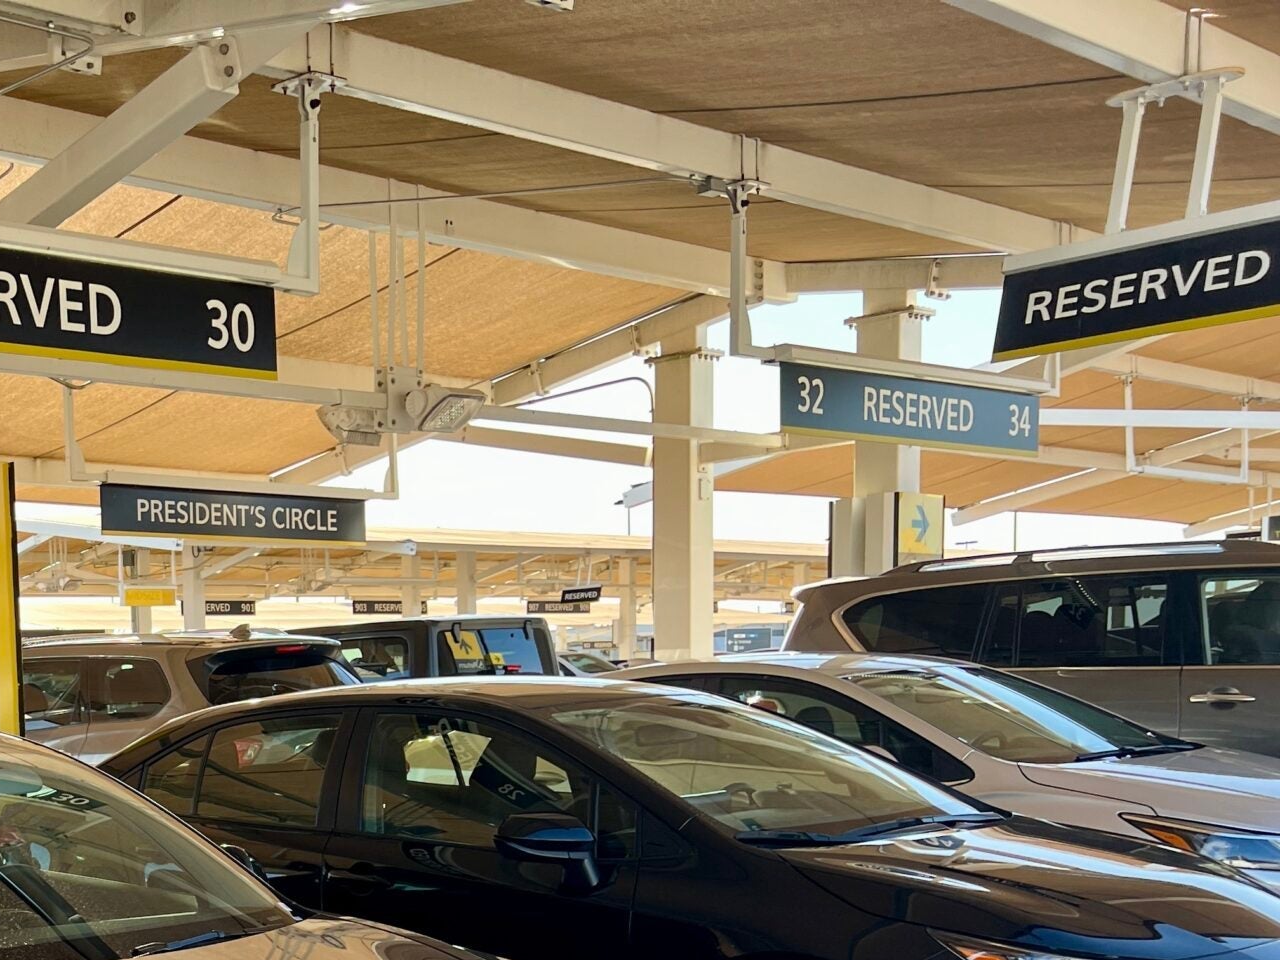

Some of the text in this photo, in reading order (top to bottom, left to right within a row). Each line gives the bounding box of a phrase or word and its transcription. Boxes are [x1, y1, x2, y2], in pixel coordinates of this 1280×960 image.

[1024, 250, 1271, 325] RESERVED
[206, 299, 256, 353] 30
[797, 376, 1031, 437] 32 RESERVED 34
[137, 498, 338, 531] PRESIDENT'S CIRCLE
[206, 603, 254, 613] ERVED 901
[355, 603, 402, 612] 903 RESERVE
[564, 590, 598, 600] RESERVED
